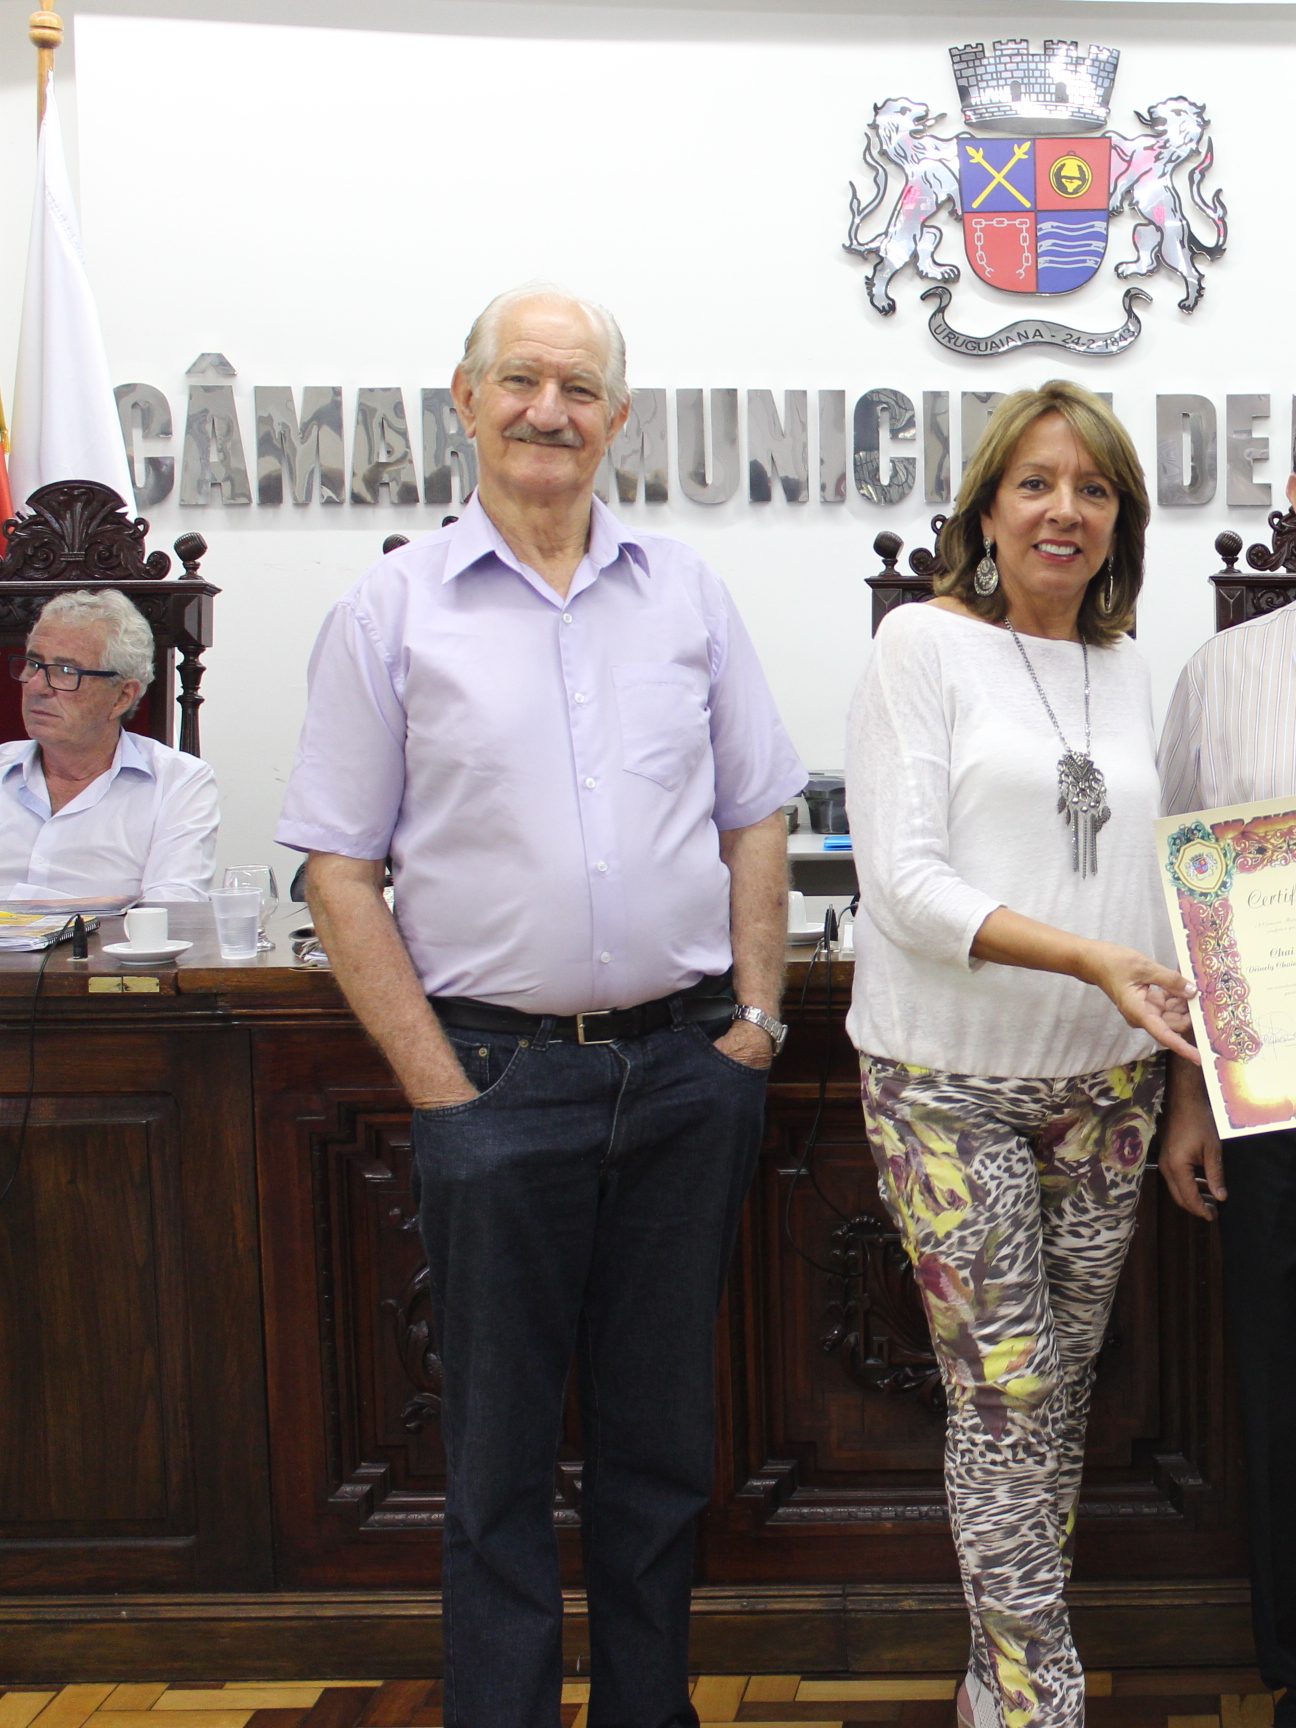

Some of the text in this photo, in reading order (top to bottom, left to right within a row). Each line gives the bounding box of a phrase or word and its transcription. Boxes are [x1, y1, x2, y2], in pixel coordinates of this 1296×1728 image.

[934, 324, 1044, 352] URUGUAIANA
[113, 352, 476, 507] CÂMAR
[594, 387, 1113, 507] MUNICI
[1156, 393, 1272, 506] DE
